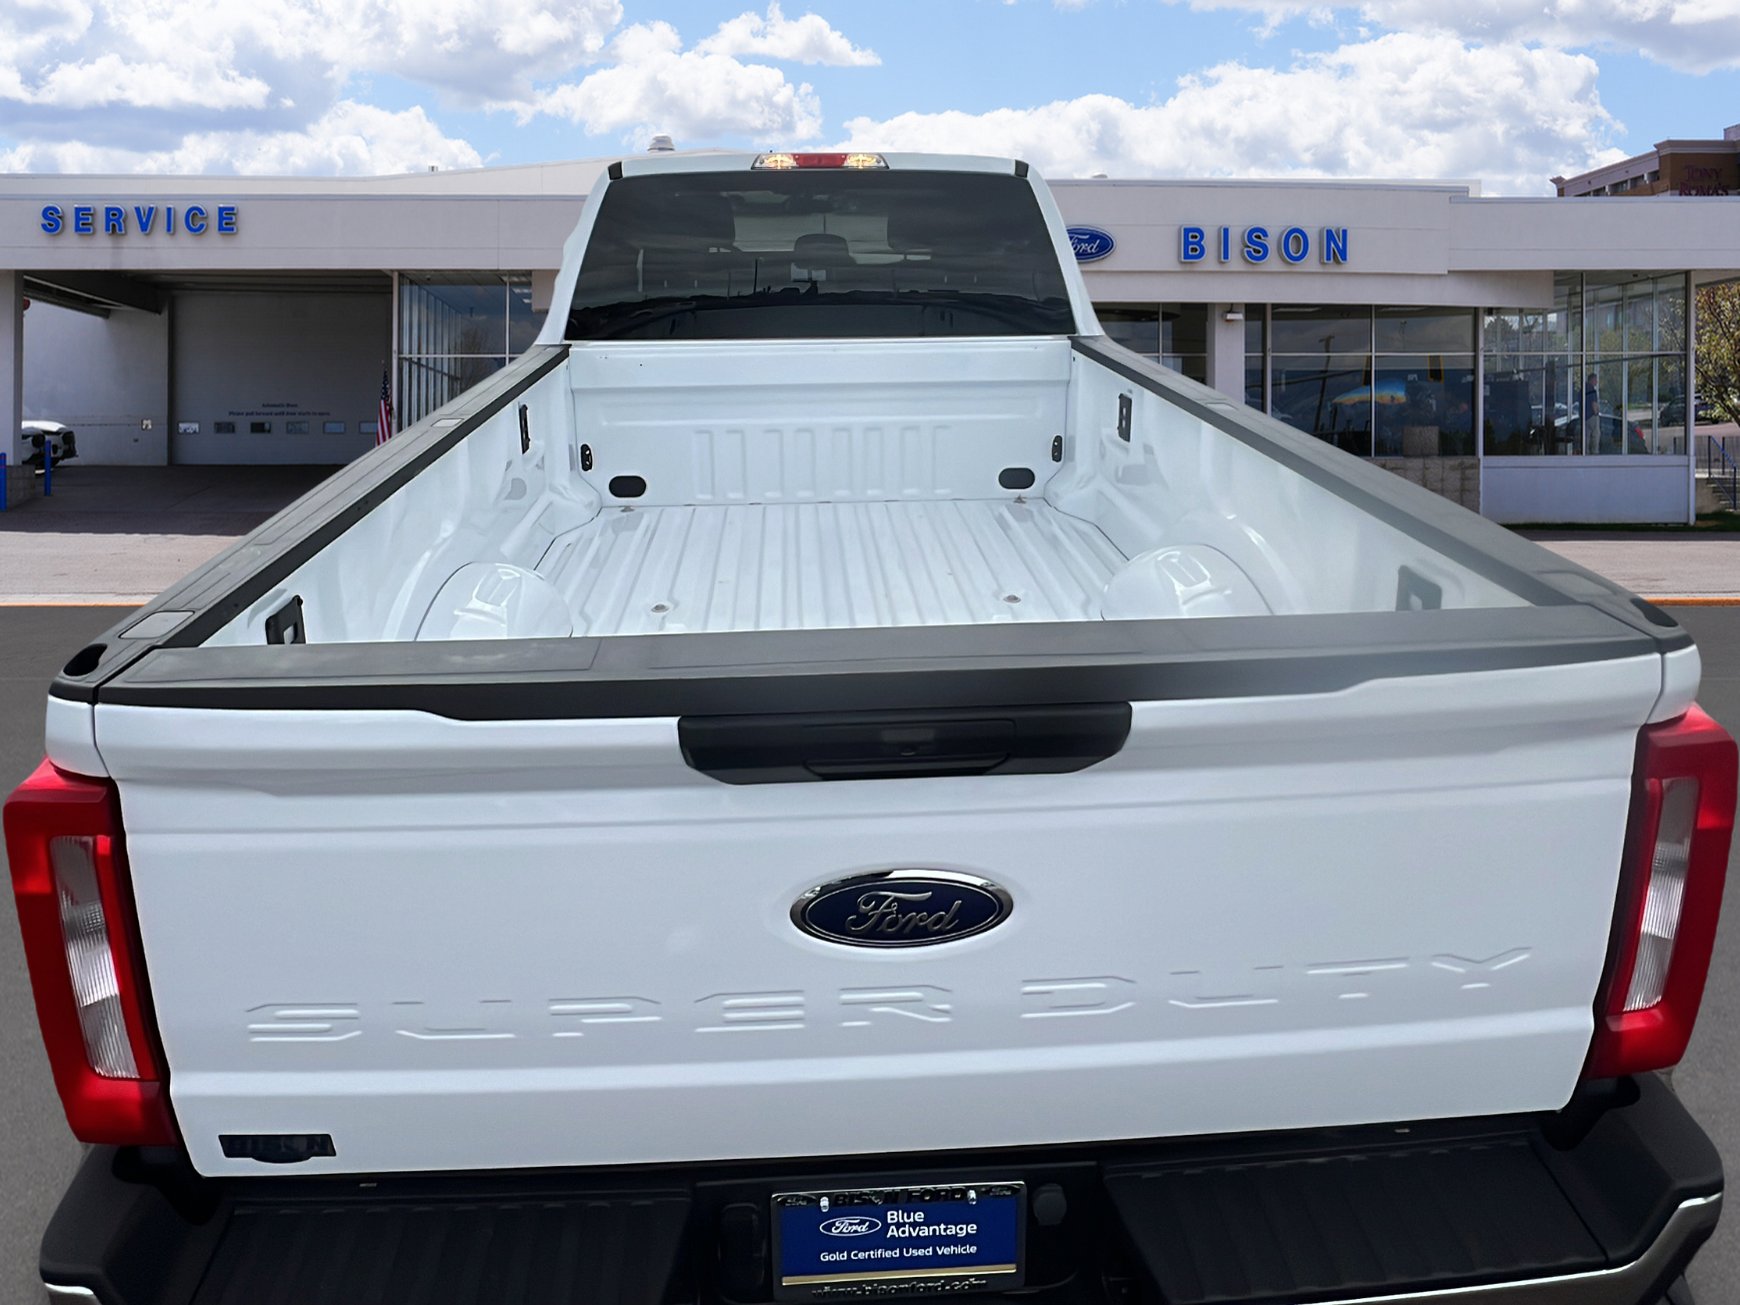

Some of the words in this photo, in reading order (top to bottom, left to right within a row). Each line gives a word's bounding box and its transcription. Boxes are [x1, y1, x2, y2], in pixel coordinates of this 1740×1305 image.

[1683, 164, 1723, 182] TONY
[41, 203, 239, 237] SERVICE
[1180, 225, 1349, 265] BISON
[845, 890, 962, 934] Ford
[246, 984, 953, 1043] SUPER
[1020, 946, 1532, 1019] DUTY
[886, 1209, 925, 1224] Blue
[831, 1219, 870, 1233] Ford
[886, 1223, 978, 1239] Advantage
[820, 1250, 848, 1262] Gold
[850, 1247, 900, 1260] Certified
[903, 1246, 933, 1257] Used
[935, 1244, 978, 1256] Vehicle
